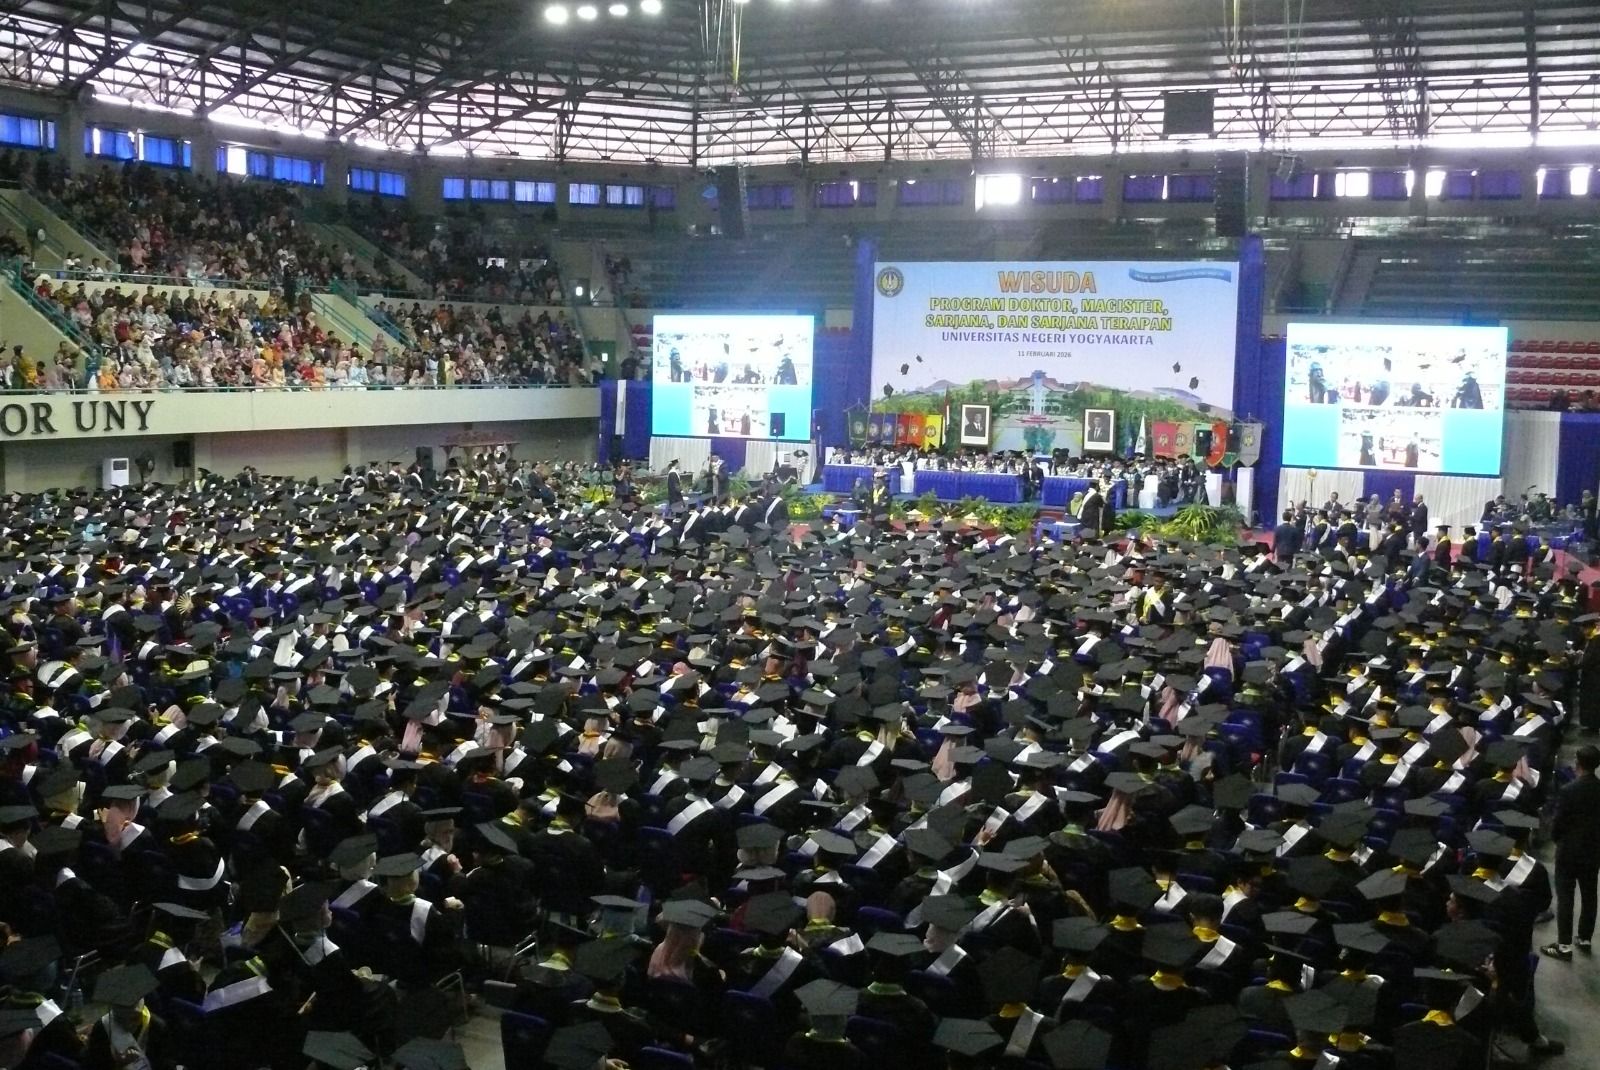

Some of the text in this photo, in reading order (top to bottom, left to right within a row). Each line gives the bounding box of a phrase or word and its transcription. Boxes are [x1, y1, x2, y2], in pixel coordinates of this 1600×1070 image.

[997, 271, 1096, 294] WISUDA
[929, 297, 1169, 315] PROGRAM DOKTOR, MAGISTER,
[925, 314, 1172, 331] SARJANA, DAN SARJANA TERAPAN
[942, 332, 1153, 345] UNIVERSITAS NEGERI YOGYAKARTA
[1026, 350, 1056, 358] FEBRUARI
[72, 400, 156, 432] UNY
